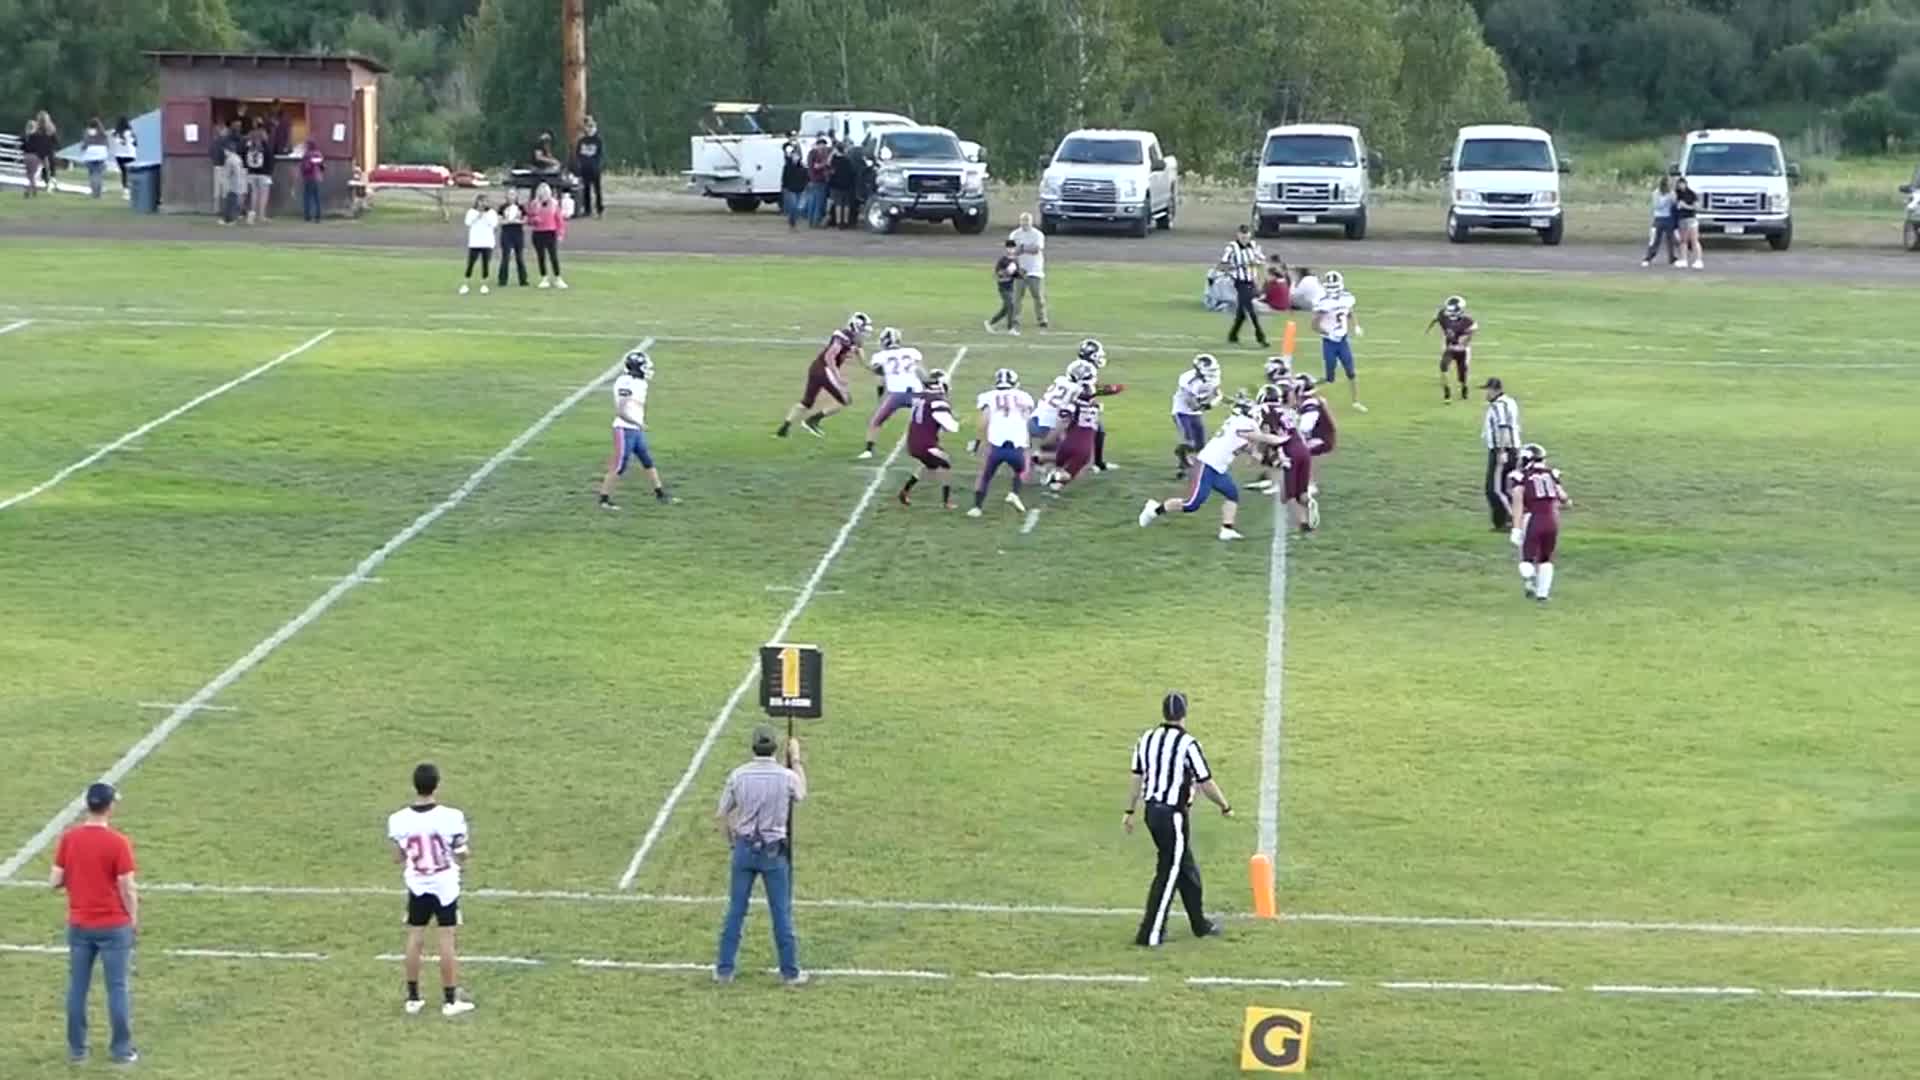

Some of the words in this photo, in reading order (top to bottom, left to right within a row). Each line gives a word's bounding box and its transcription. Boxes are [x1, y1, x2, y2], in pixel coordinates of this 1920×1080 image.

[776, 648, 801, 698] 1
[403, 830, 452, 875] 20
[1249, 1014, 1302, 1067] G
